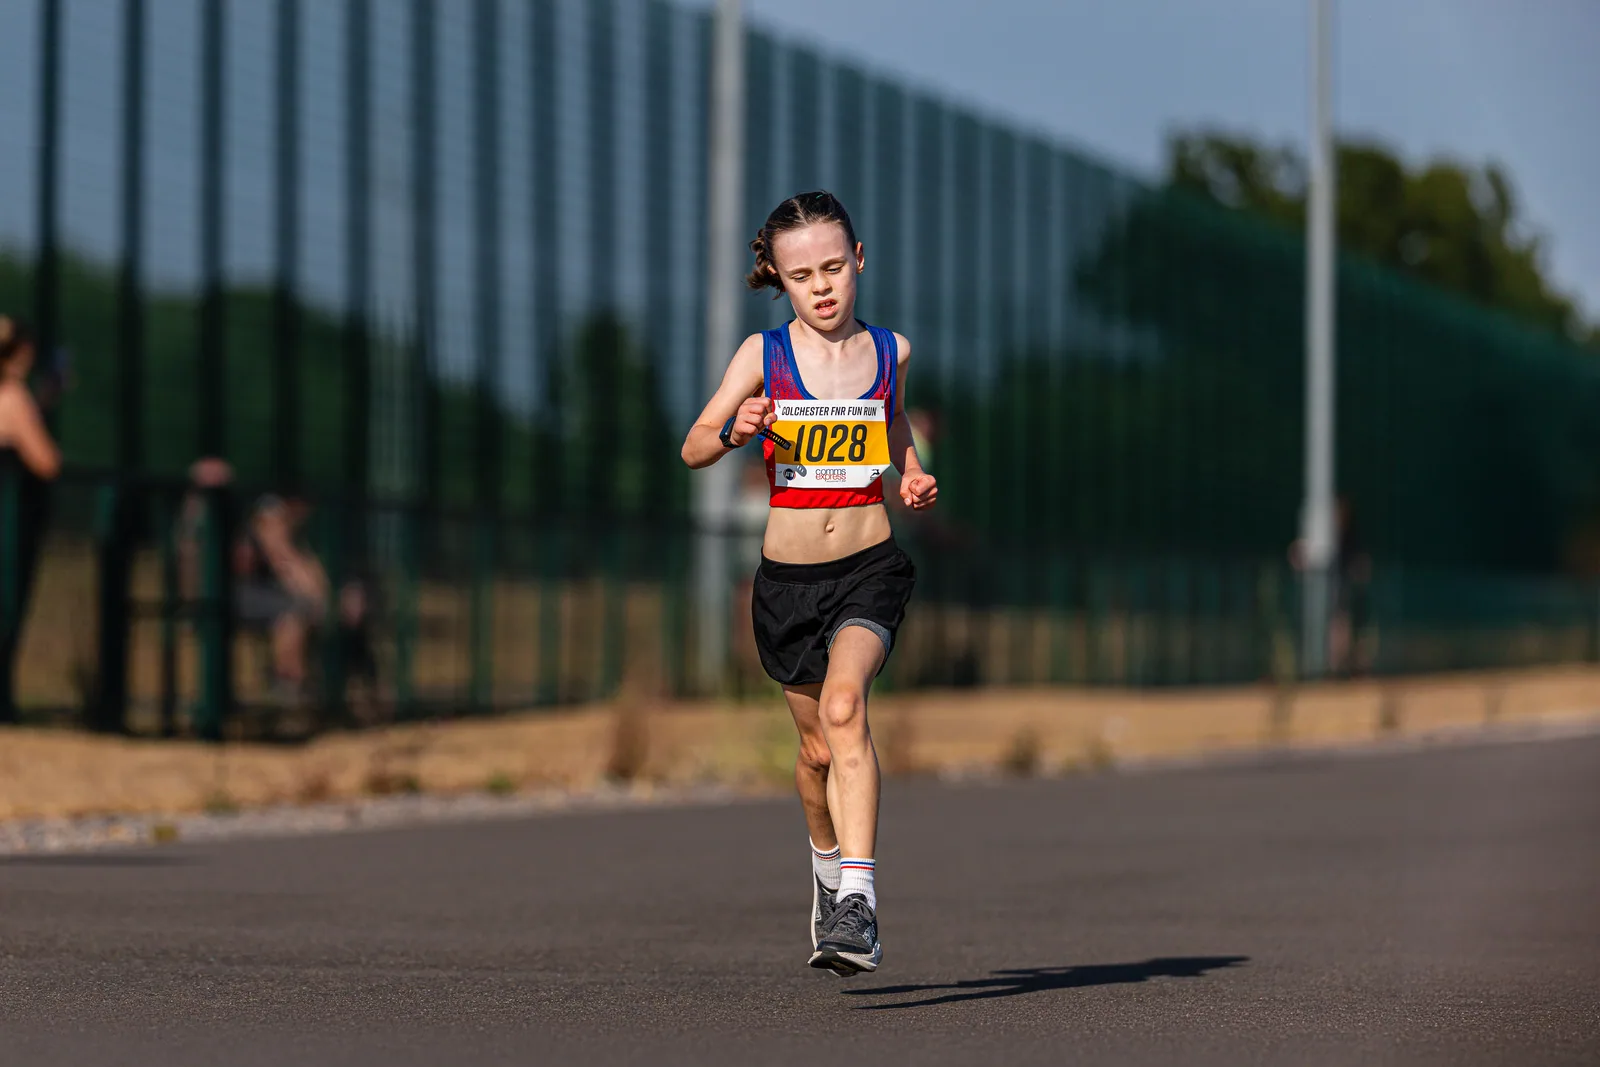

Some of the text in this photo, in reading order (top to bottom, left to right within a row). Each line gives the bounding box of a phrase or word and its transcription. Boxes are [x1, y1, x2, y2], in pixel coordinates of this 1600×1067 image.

[782, 406, 877, 417] COLCHESTER FNR FUN RUN
[794, 424, 867, 462] 1028
[815, 474, 846, 482] express
